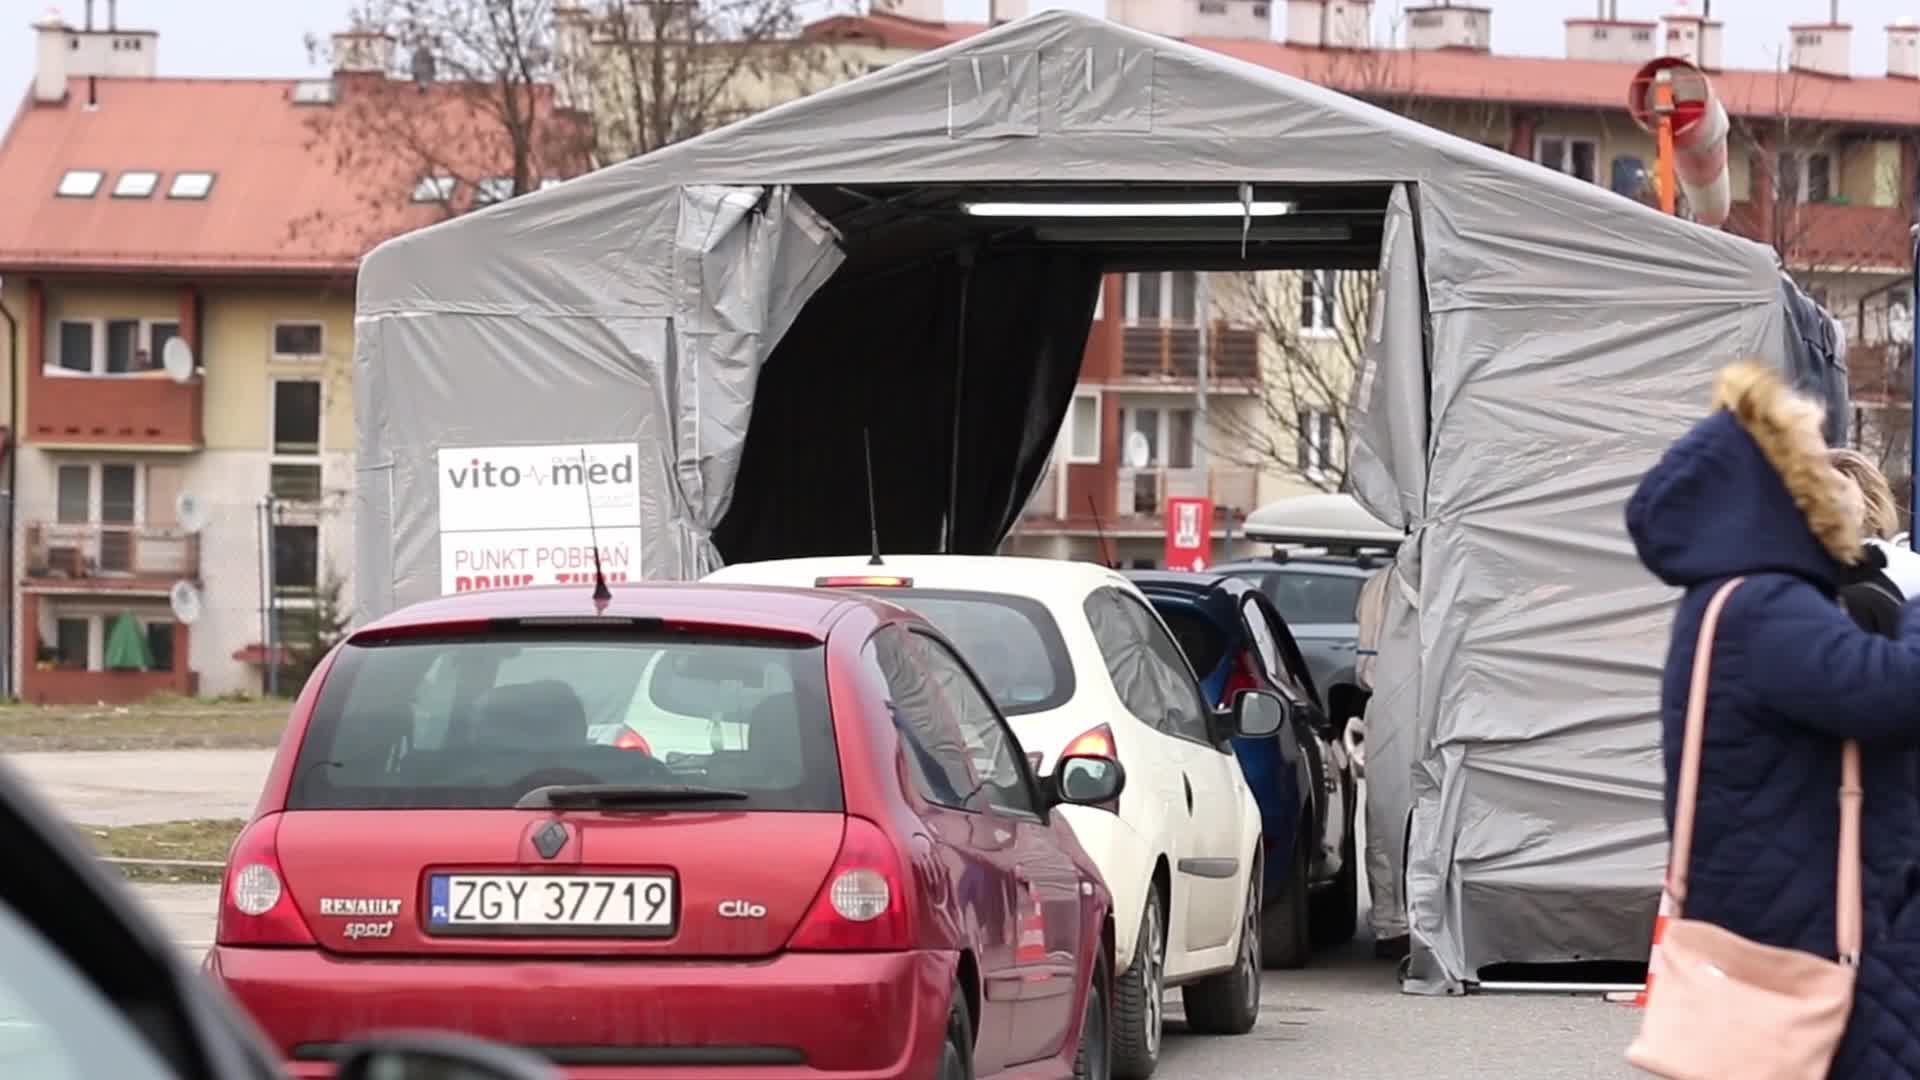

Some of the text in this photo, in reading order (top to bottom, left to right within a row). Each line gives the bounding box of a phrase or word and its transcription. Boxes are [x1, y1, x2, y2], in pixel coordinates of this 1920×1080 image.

[448, 455, 632, 488] vito med
[455, 542, 629, 571] PUNKT POBRAŃ
[320, 897, 402, 915] RENAULT
[454, 880, 667, 922] ZGY 37719
[718, 899, 767, 918] Clio
[432, 905, 447, 918] PL
[343, 920, 394, 940] sport
